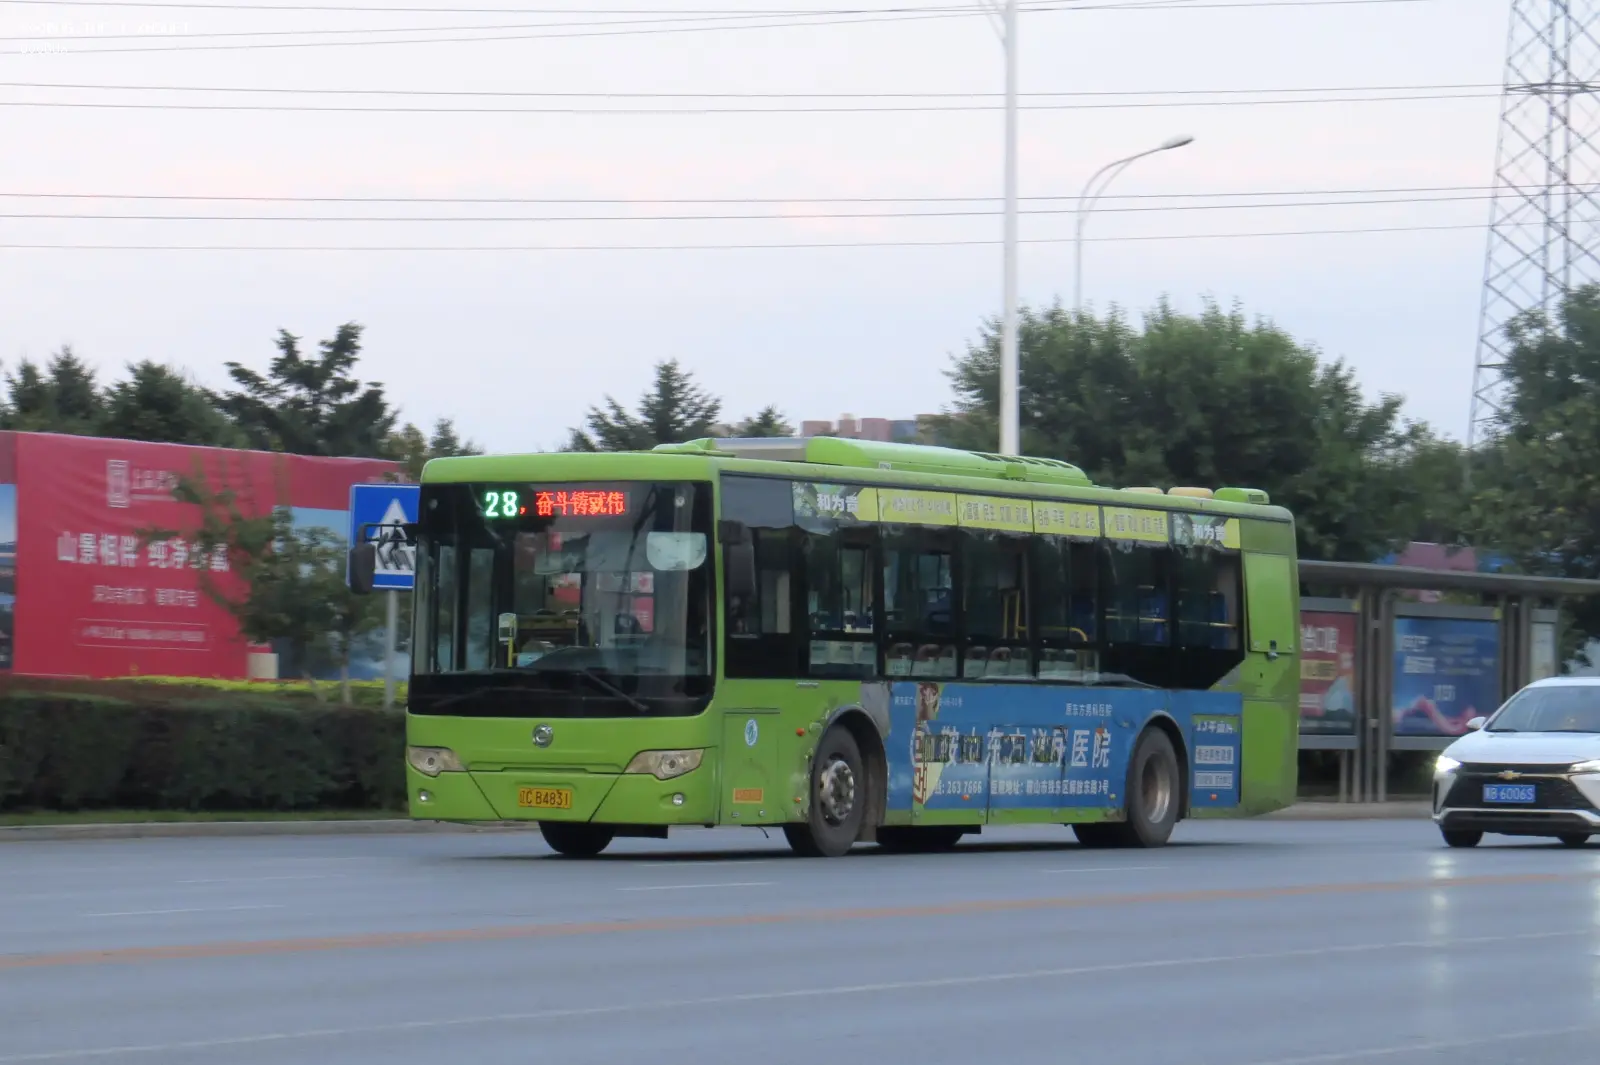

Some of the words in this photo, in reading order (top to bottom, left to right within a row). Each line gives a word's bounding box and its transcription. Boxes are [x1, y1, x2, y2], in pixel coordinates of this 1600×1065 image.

[485, 491, 518, 516] 28
[817, 492, 858, 513] 和为贵
[1192, 521, 1225, 541] 和为贵
